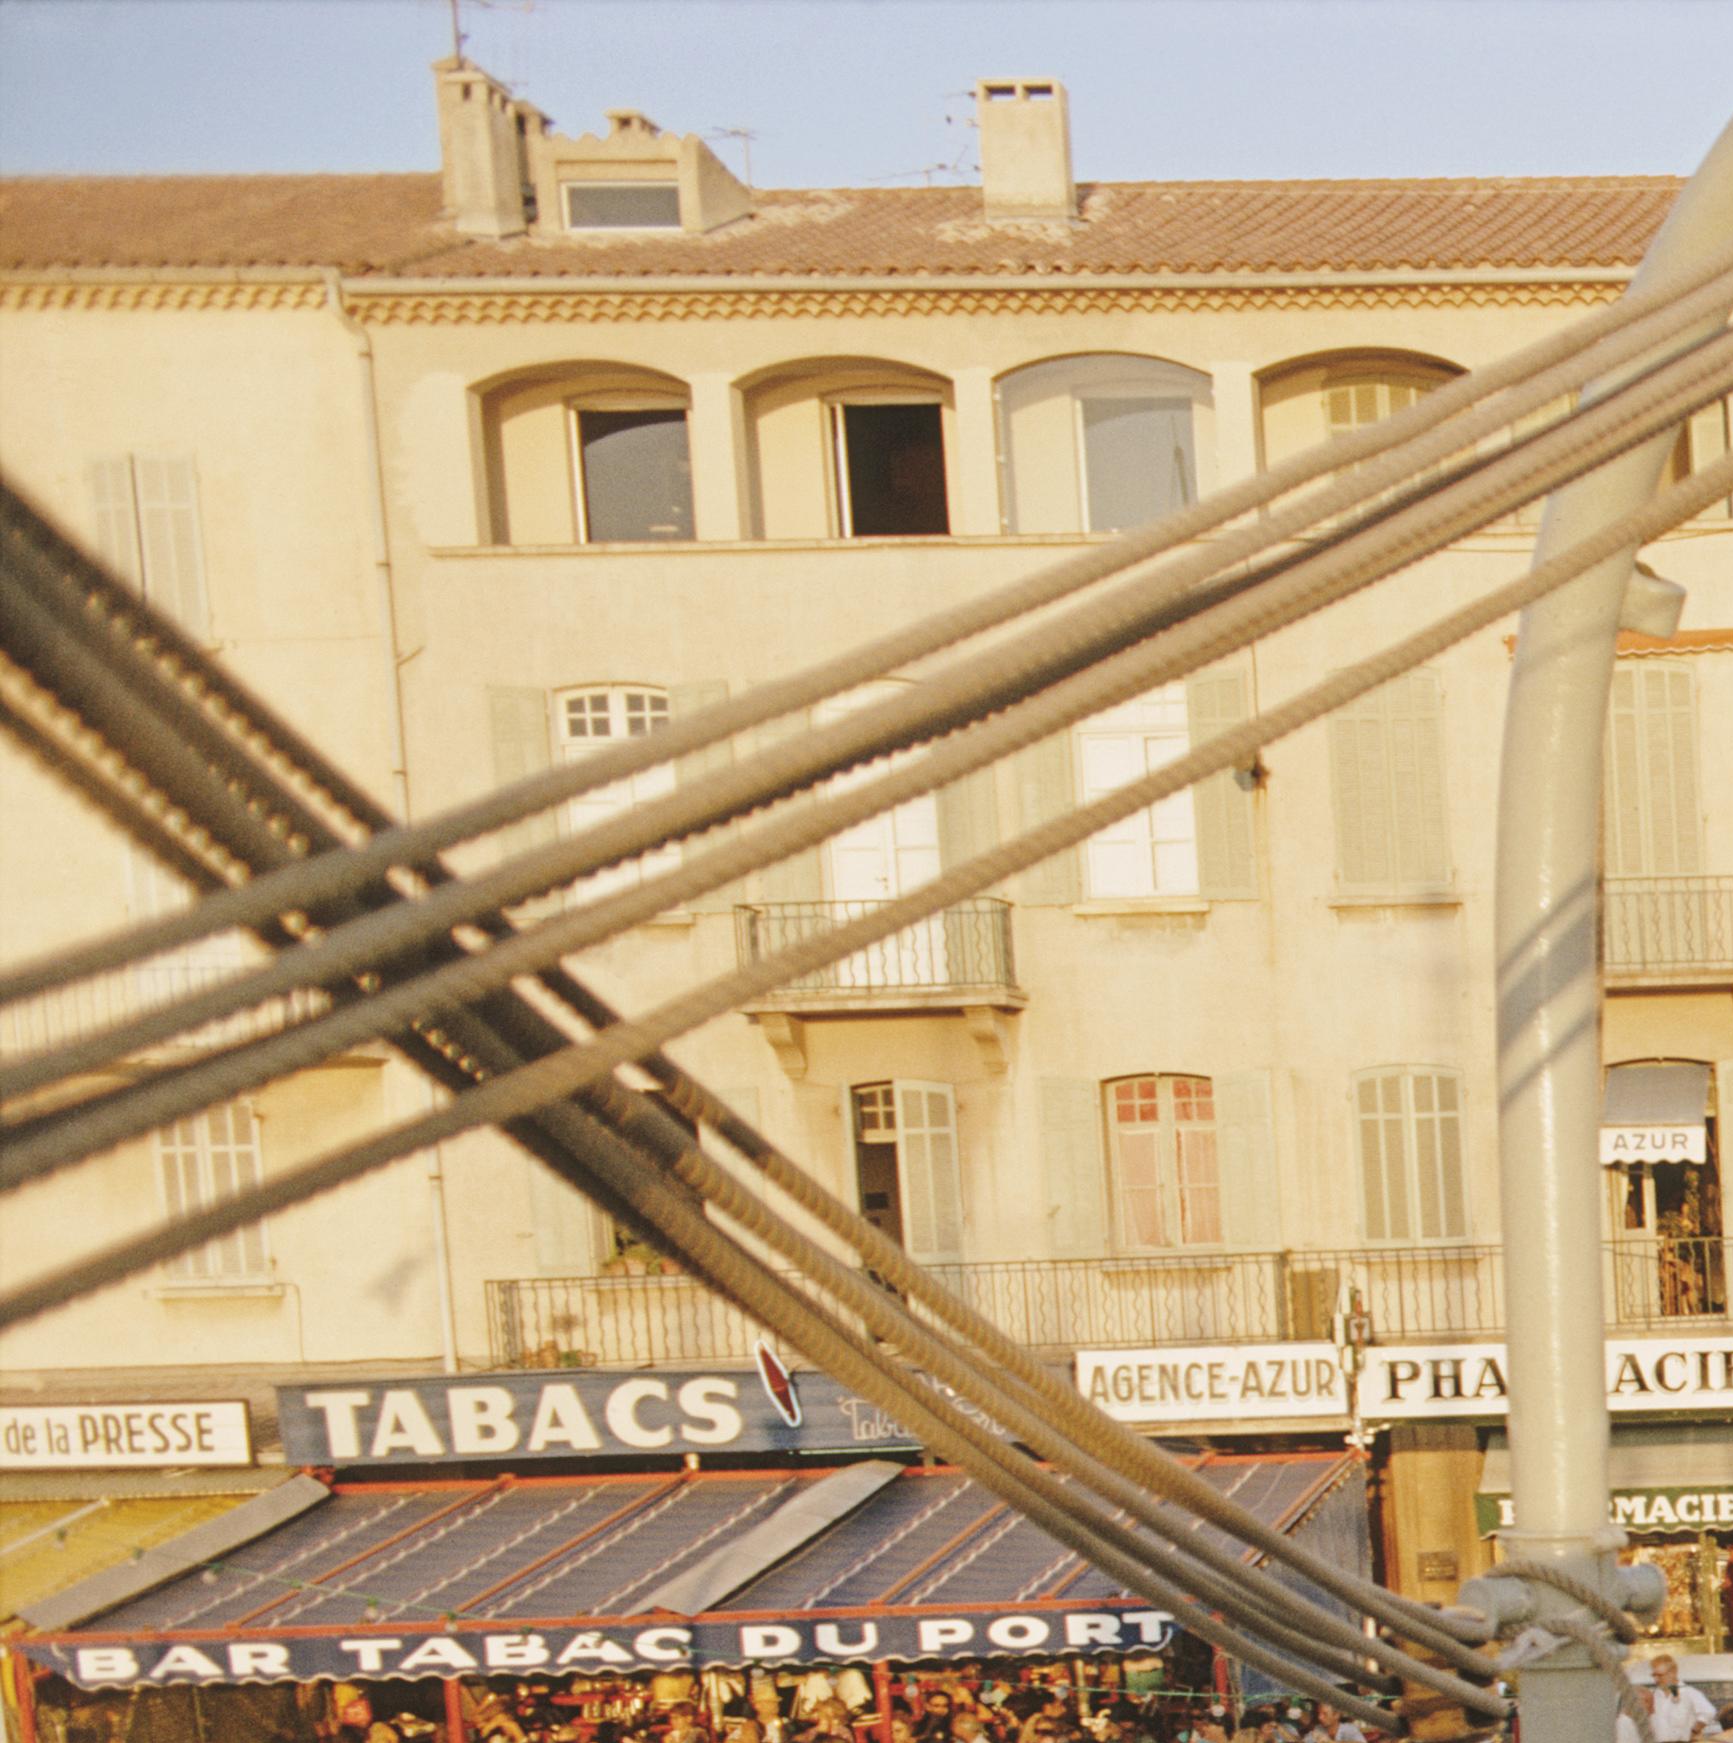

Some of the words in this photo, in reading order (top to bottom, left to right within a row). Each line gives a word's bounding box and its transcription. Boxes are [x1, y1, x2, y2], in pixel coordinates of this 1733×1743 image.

[1612, 1131, 1689, 1153] AZUR
[1087, 1357, 1337, 1403] AGENCE-AZUR
[4, 1416, 37, 1456] de
[45, 1417, 70, 1455] la
[78, 1411, 216, 1455] PRESSE
[306, 1377, 744, 1461] TABACS
[75, 1641, 290, 1682] BAR
[340, 1627, 692, 1671] TABAC
[740, 1620, 878, 1659] DU
[918, 1611, 1177, 1655] PORT
